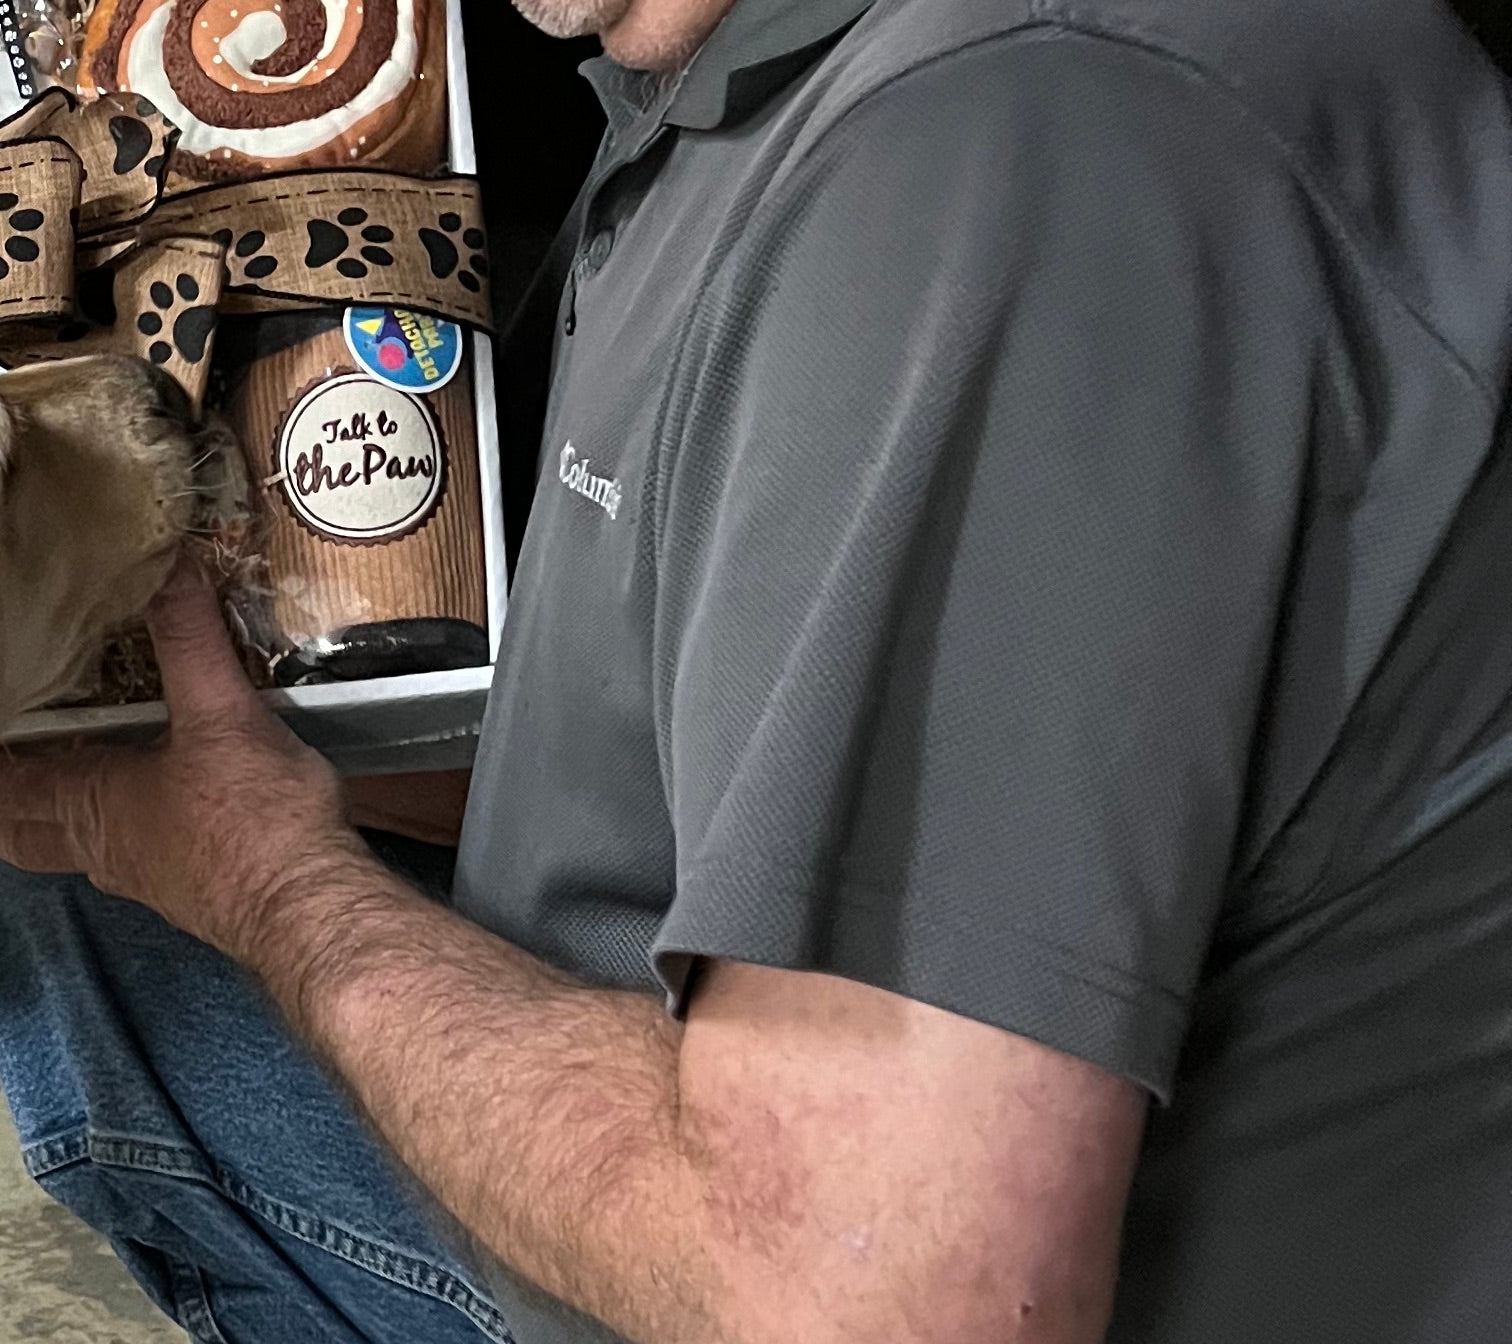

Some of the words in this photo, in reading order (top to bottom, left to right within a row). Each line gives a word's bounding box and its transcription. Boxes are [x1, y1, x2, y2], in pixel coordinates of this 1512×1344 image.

[322, 412, 373, 444] Talk
[293, 443, 362, 497] the
[362, 443, 433, 486] Paw
